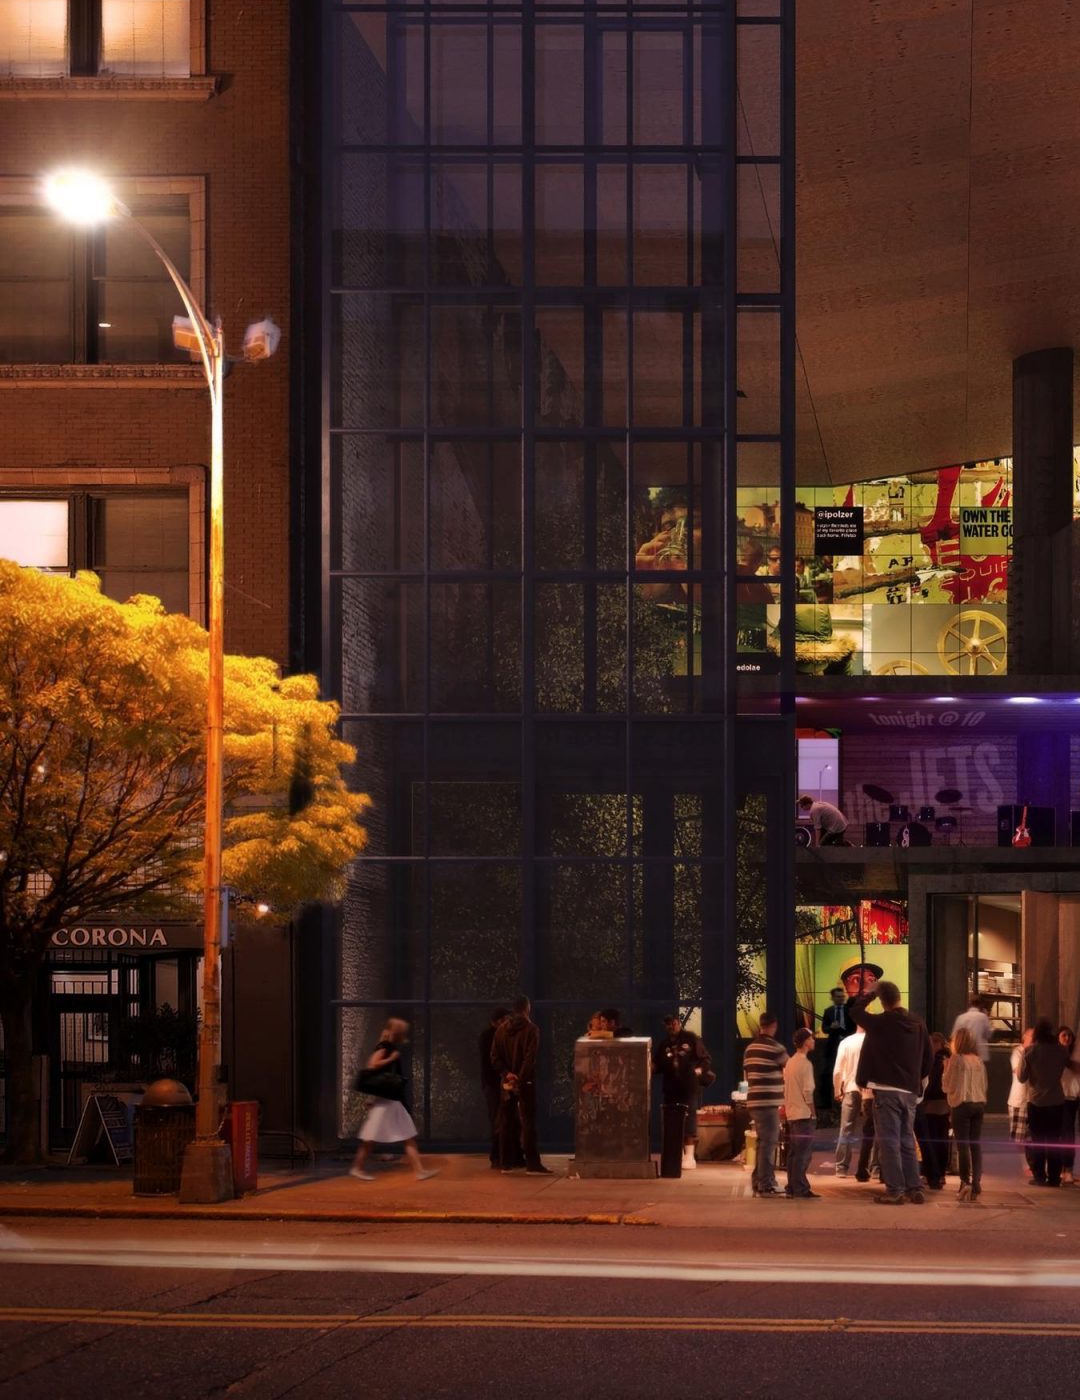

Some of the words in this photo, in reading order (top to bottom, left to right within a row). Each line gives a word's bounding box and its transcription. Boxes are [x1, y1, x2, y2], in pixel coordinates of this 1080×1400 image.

[817, 510, 854, 520] @ipolzer
[963, 509, 987, 523] OWN
[989, 509, 1011, 523] THE
[963, 524, 999, 538] WATER
[867, 710, 935, 728] tonight
[961, 711, 986, 727] 10
[52, 928, 168, 946] CORONA
